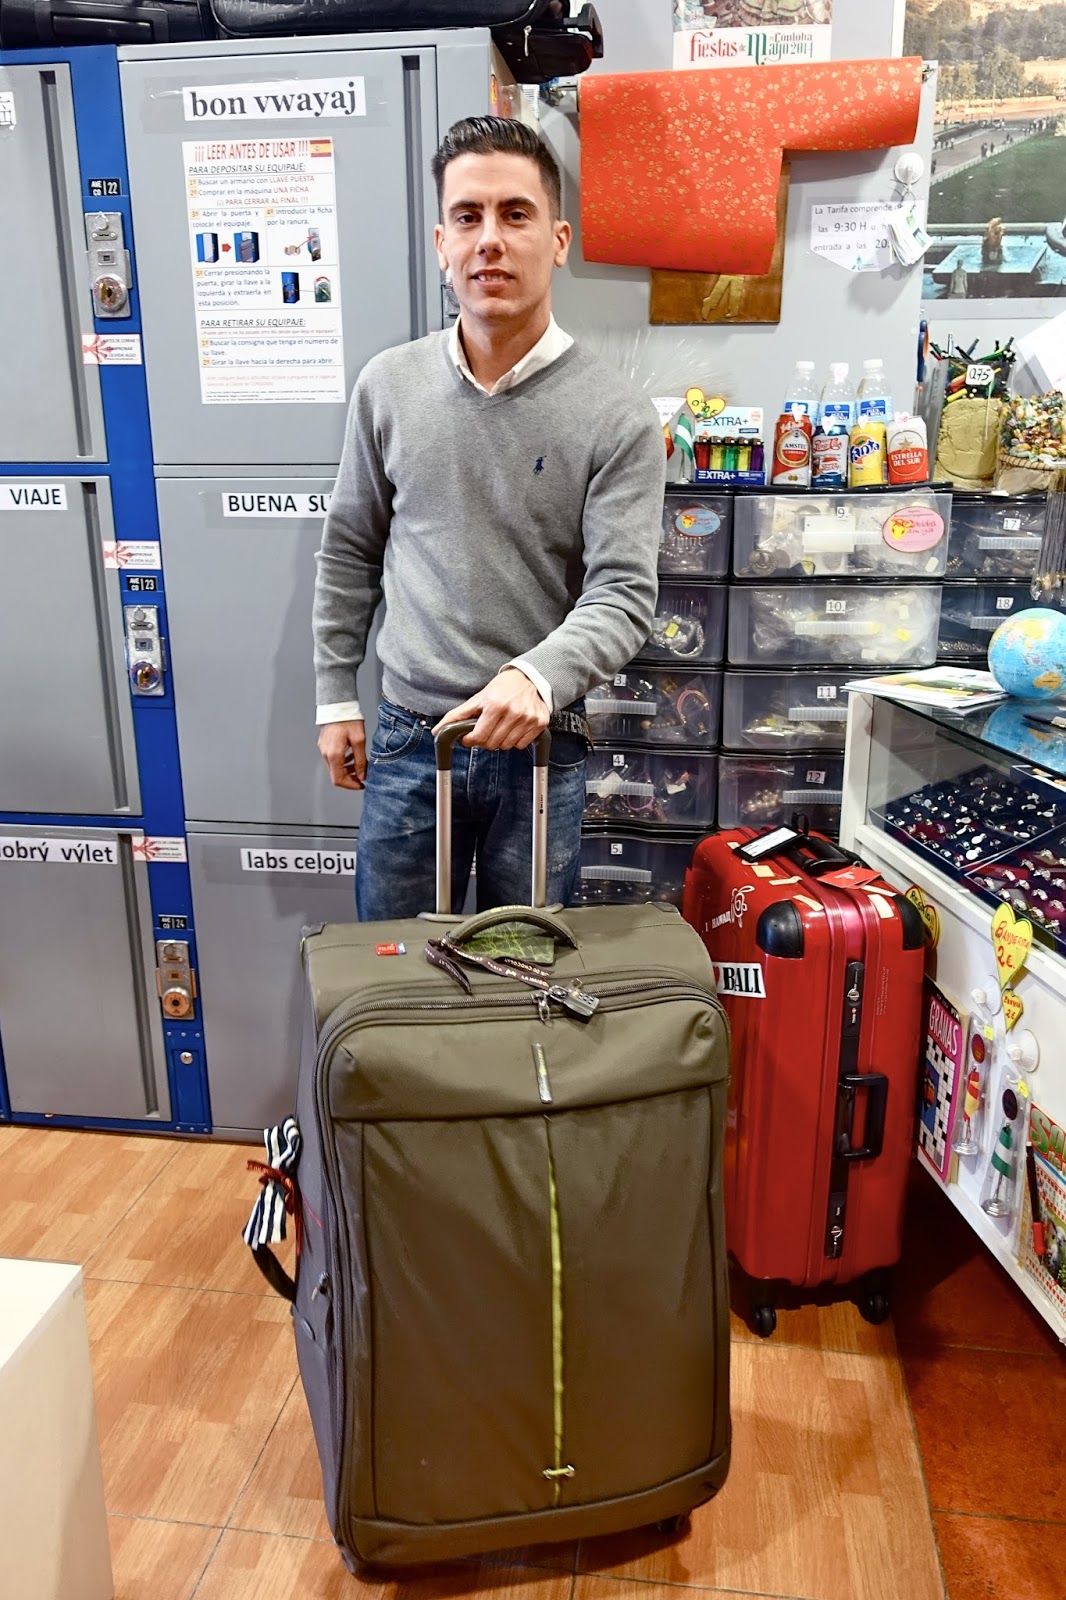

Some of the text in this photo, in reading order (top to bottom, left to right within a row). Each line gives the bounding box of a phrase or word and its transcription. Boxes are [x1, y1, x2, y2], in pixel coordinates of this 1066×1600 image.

[690, 31, 738, 62] fiestas
[190, 82, 356, 117] bon vwayaj
[207, 144, 226, 160] LEER
[229, 143, 256, 159] ANTES
[259, 142, 270, 158] DE
[273, 142, 295, 158] USAR
[211, 165, 252, 173] DEPOSITAR
[267, 163, 306, 172] EQUIPAJE:
[107, 182, 118, 194] 22
[850, 204, 893, 215] comprende
[834, 222, 856, 232] 9:30
[860, 222, 866, 230] H
[268, 318, 306, 327] EQUIPAJE:
[891, 451, 923, 461] ESTRELLA
[698, 471, 736, 480] EXTRA+
[9, 488, 62, 505] VIAJE
[228, 495, 298, 512] BUENA
[145, 580, 154, 590] 23
[828, 601, 845, 612] 10.
[616, 676, 626, 686] 3.
[820, 687, 835, 698] 11.
[614, 756, 624, 766] 4.
[0, 841, 113, 863] obrý výlet
[612, 844, 622, 854] 5.
[248, 851, 288, 869] labs
[722, 967, 762, 994] BALI
[929, 1000, 958, 1056] GRAMAS
